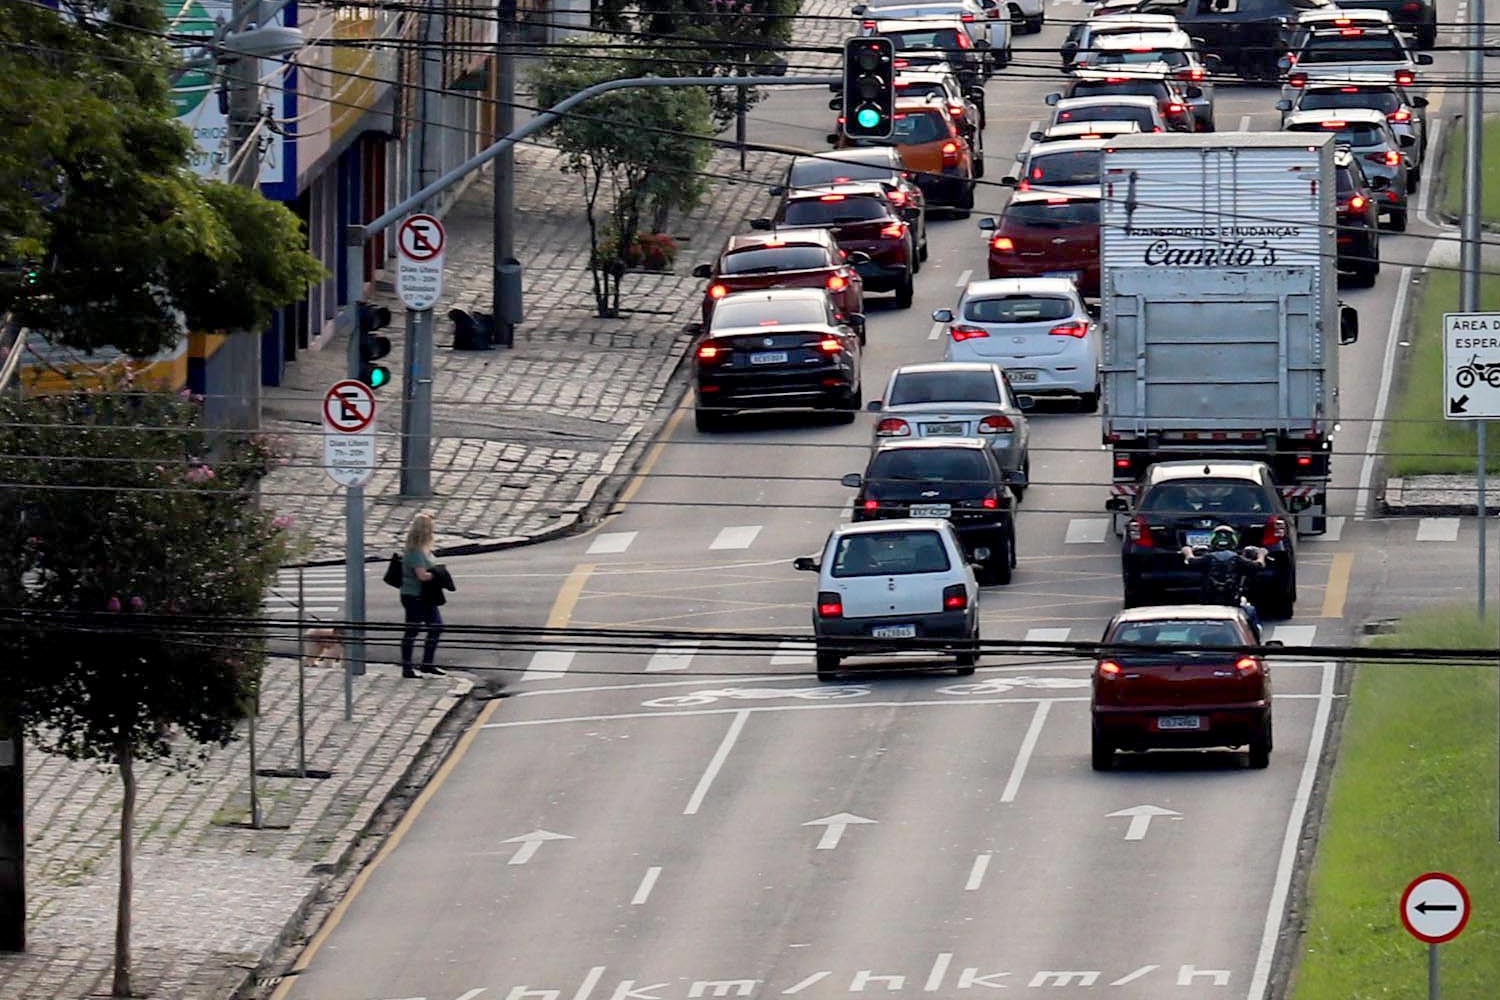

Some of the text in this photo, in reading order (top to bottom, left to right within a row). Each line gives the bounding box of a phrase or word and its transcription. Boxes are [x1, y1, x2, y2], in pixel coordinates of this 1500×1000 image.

[1126, 227, 1217, 237] TRANSPORTES
[1231, 226, 1300, 239] MUDANÇAS
[1452, 317, 1488, 330] ÁREA
[957, 964, 1233, 989] km/h
